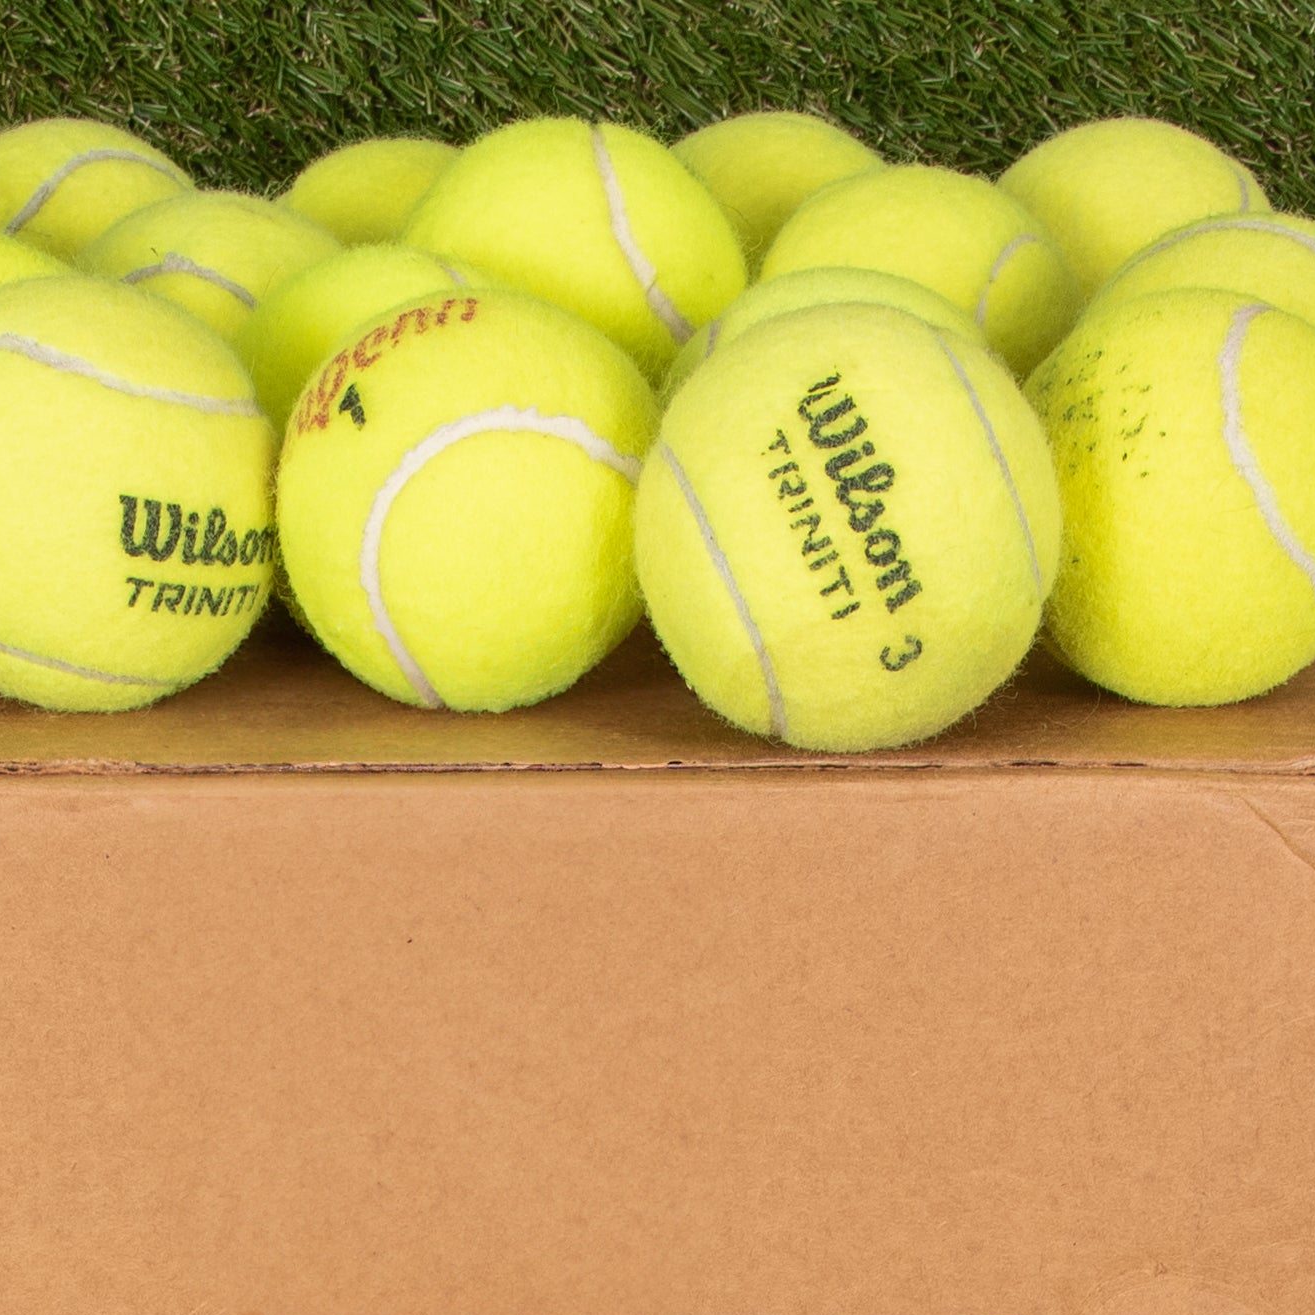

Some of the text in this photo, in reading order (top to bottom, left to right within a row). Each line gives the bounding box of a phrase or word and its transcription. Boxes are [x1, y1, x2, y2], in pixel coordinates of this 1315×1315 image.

[125, 576, 261, 617] TRINITI
[767, 428, 861, 620] TRINITI
[797, 370, 923, 672] Wilson 3
